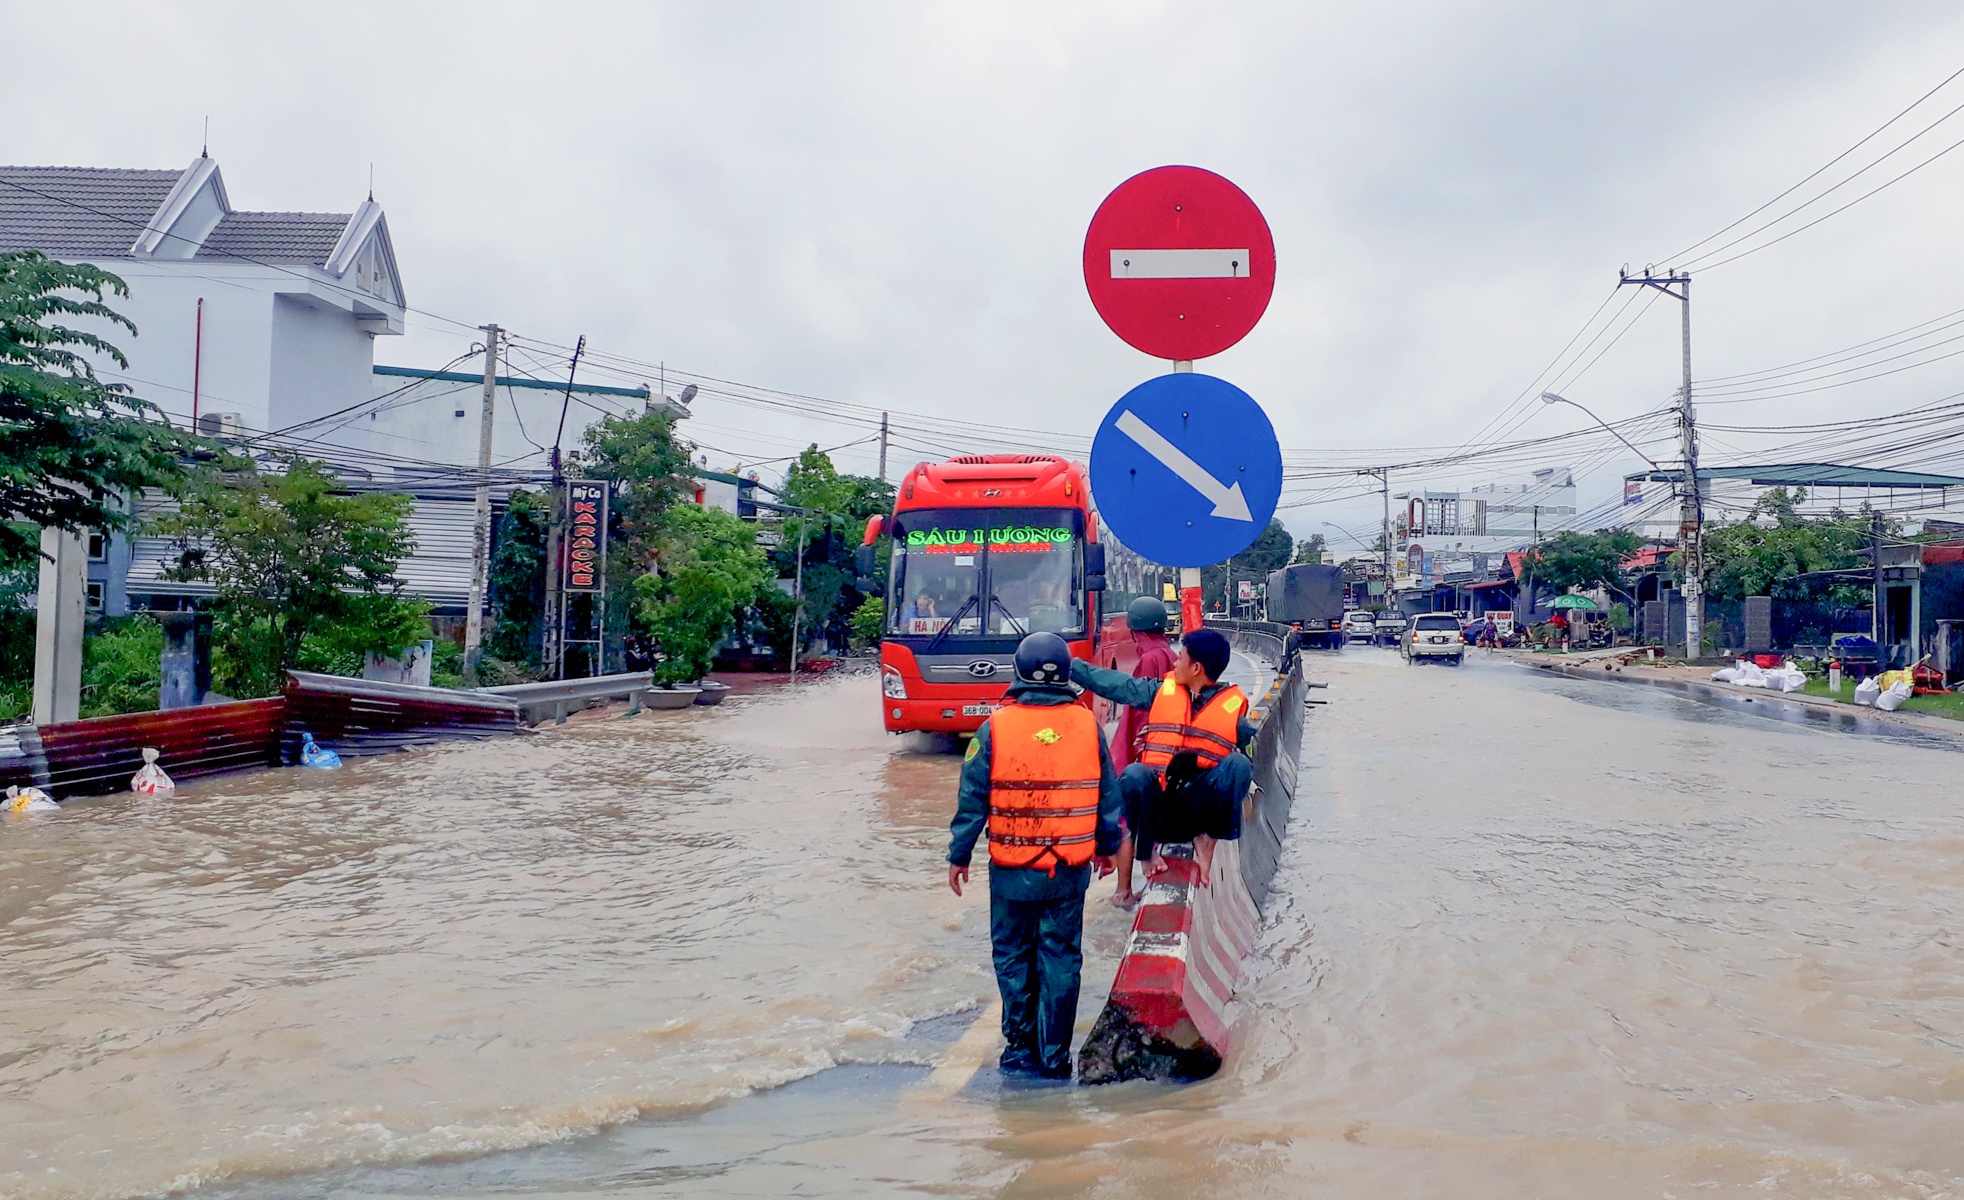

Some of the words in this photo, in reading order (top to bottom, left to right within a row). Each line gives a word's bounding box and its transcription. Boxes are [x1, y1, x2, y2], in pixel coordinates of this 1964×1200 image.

[572, 486, 587, 500] Mỹ
[588, 487, 601, 499] Ca
[571, 502, 597, 585] KARAOKE
[907, 527, 966, 545] SÁU
